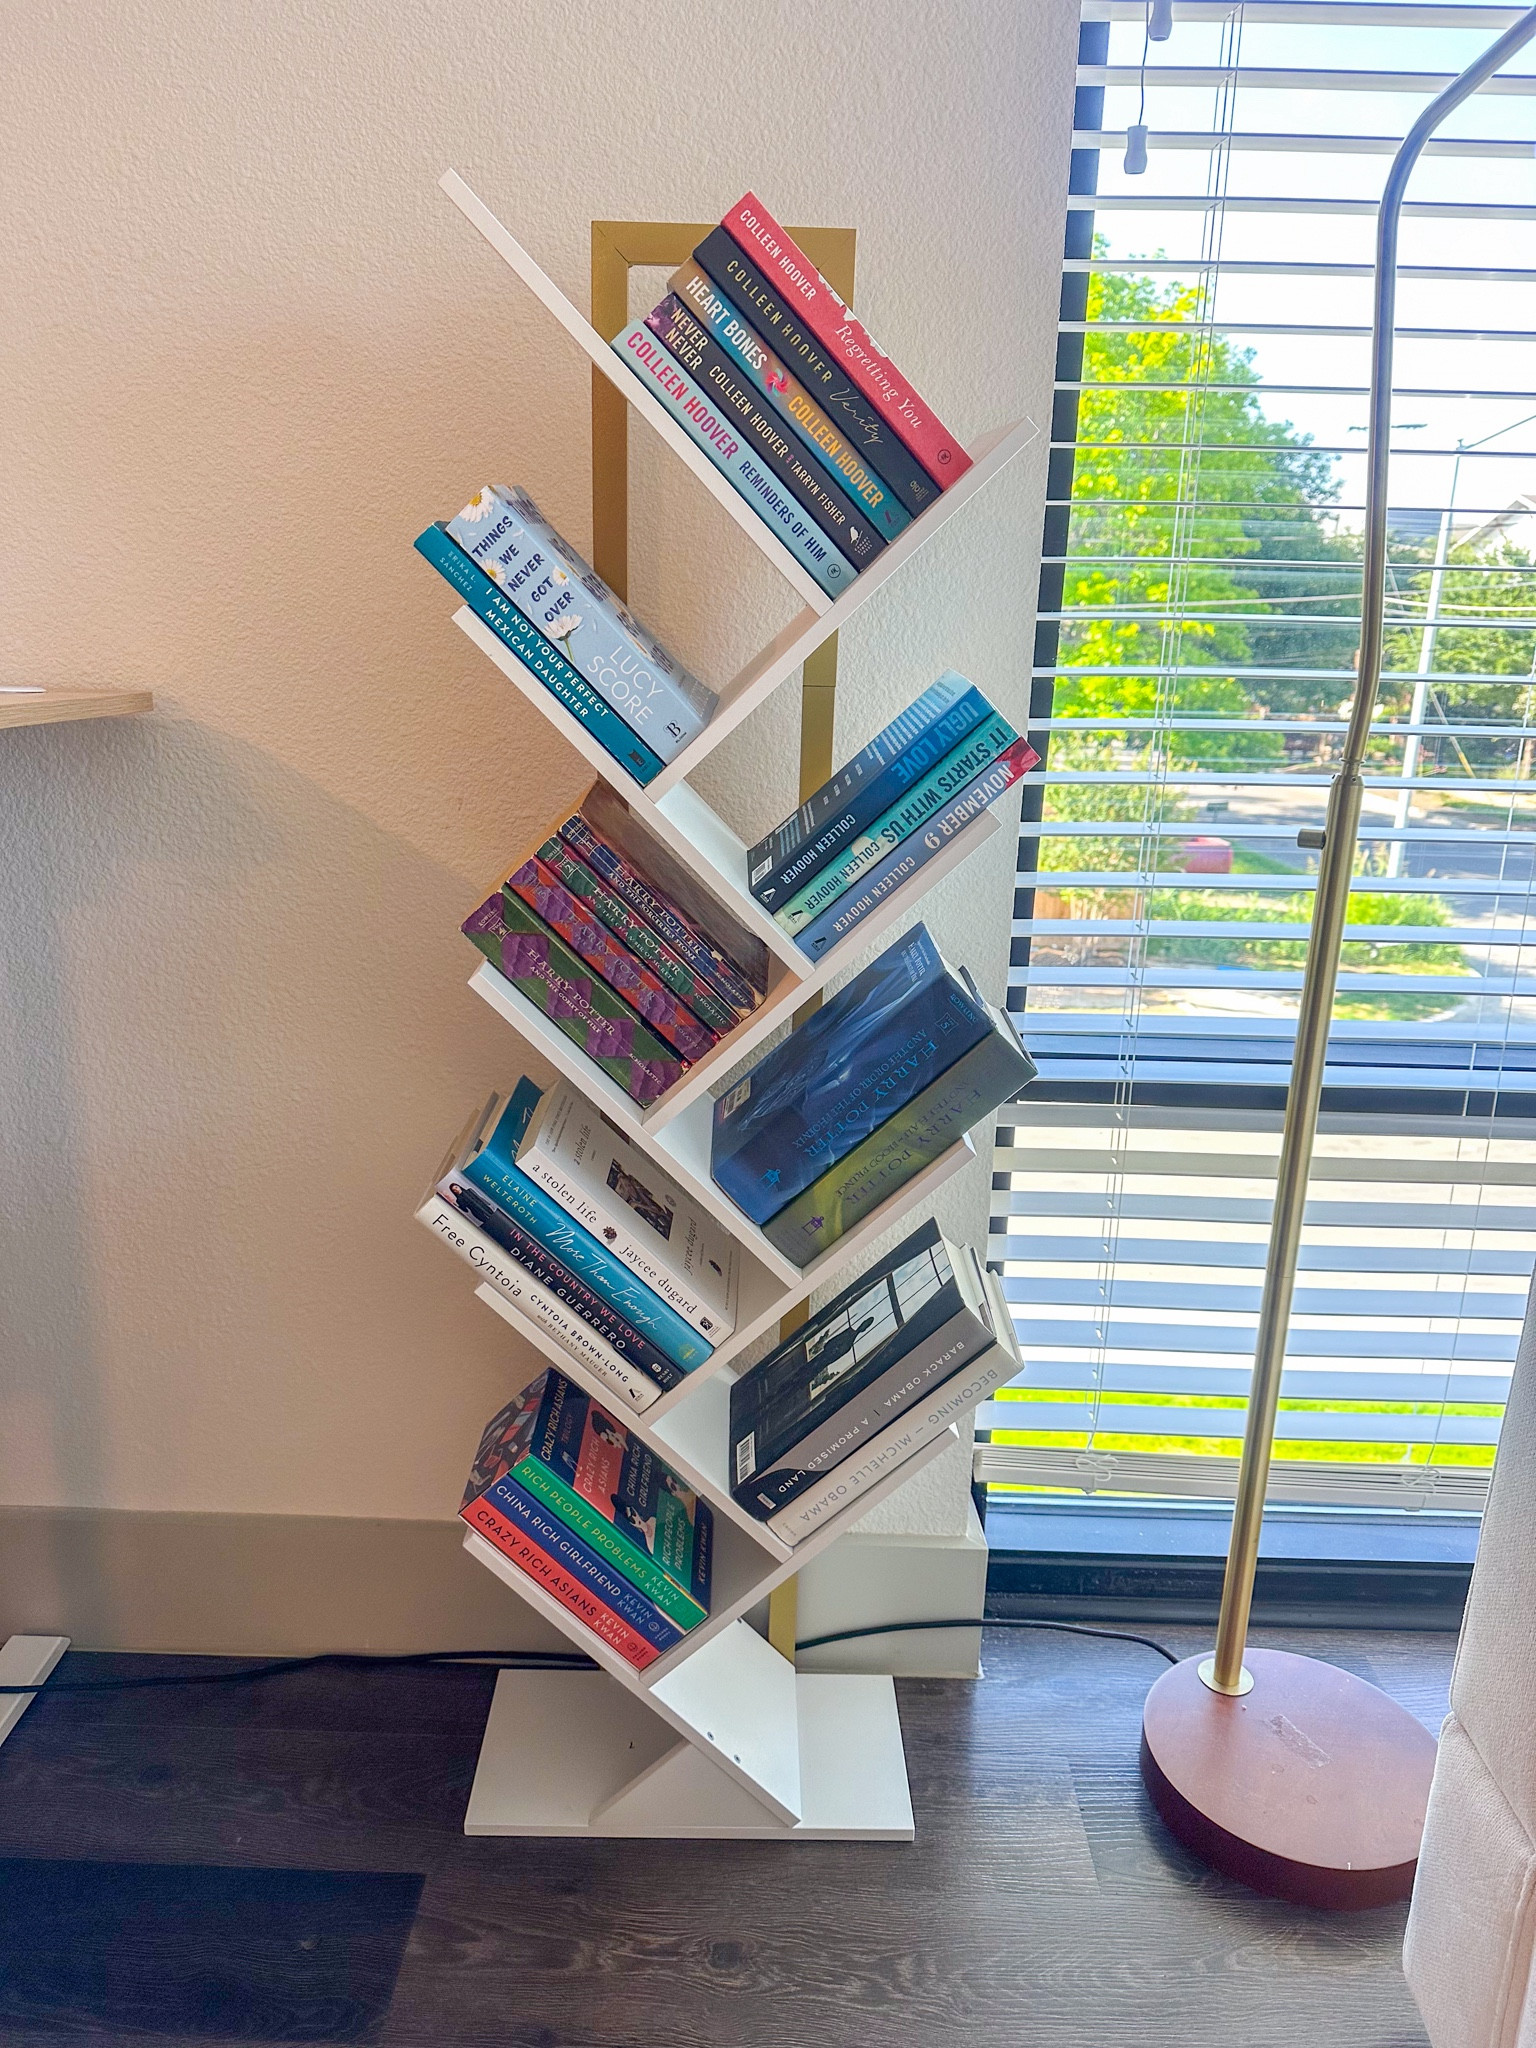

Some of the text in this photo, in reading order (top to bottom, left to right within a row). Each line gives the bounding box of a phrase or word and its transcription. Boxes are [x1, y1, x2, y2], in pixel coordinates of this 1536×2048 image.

[740, 209, 817, 300] COLLEEN HOOVER
[665, 327, 703, 371] NEVER
[671, 308, 709, 351] NEVER
[686, 276, 768, 370] HEART BONES
[727, 260, 833, 383] COLLEEN HOOVER
[627, 331, 739, 460] COLLEEN HOOVER
[835, 325, 899, 401] Regretting
[898, 398, 923, 429] You
[829, 388, 883, 444] Verity
[709, 365, 846, 526] COLLEEN HOOVER TARRYN FISHER
[788, 396, 884, 508] COLLEEN HOOVER
[472, 515, 514, 558] THINGS
[739, 460, 827, 562] REMINDERS OF HIM
[447, 550, 469, 575] ERIKA
[498, 544, 520, 566] WE
[507, 553, 545, 593] NEVER
[530, 576, 554, 603] GOT
[543, 591, 575, 623] OVER
[485, 587, 608, 717] I AM NOT YOUR PERFECT
[485, 609, 590, 718] MEXICAN DAUGHTER
[609, 645, 664, 698] LUCY
[586, 655, 654, 725] SCORE
[934, 700, 979, 747] UGLY
[880, 727, 1008, 844] IT STARTS WITH US
[891, 738, 938, 784] LOVE
[815, 813, 856, 853] COLLEEN
[924, 764, 1015, 849] NOVEMBER 9
[780, 849, 819, 884] HOOVER
[804, 841, 880, 910] COLLEEN HOOVER
[832, 856, 916, 932] COLLEEN HOOVER
[594, 886, 681, 976] HARRY POTTER
[608, 872, 697, 960] AND THE STONE
[614, 864, 701, 955] HARRY POTTER
[568, 914, 655, 1001] HARRY POTTER
[652, 959, 675, 981] SECRETS
[527, 949, 615, 1037] HARRY POTTER
[530, 966, 601, 1033] AND THE GOBLET OF FIRE
[694, 992, 726, 1025] SCHOLASTIC
[888, 1048, 908, 1066] THE
[907, 1029, 927, 1049] AND
[629, 1053, 662, 1084] SCHOLASTIC
[849, 1087, 862, 1100] OF
[860, 1063, 889, 1089] ORDER
[803, 1039, 939, 1157] HARRY POTTER
[792, 1113, 833, 1149] PHOENIX
[846, 1089, 981, 1205] HARRY POTTER
[483, 1173, 538, 1225] WELTEROTH
[502, 1175, 537, 1208] ELAINE
[532, 1163, 597, 1224] a stolen life
[835, 1165, 869, 1197] PRINCE
[432, 1214, 522, 1297] Free Cyntoia
[545, 1222, 662, 1330] More Than Enough
[619, 1244, 657, 1279] jaycee
[658, 1277, 699, 1315] dugard
[509, 1228, 646, 1350] IN THE COUNTRY WE LOVE
[510, 1247, 626, 1349] DIANE GUERRERO
[530, 1294, 629, 1383] CYNTOIA BROWN-LONG
[547, 1322, 580, 1353] BETHANY
[580, 1351, 609, 1377] MAUGER
[541, 1379, 568, 1461] CRAZY RICH ASIANS
[778, 1341, 965, 1494] BARACK OBAMA A PROMISED LAND
[800, 1369, 998, 1522] BECOMING MICHELLE OBAMA
[583, 1437, 600, 1493] CRAZY RICH
[598, 1457, 610, 1494] ASIANS
[627, 1442, 642, 1496] CHINA RICH
[639, 1453, 652, 1507] GIRLFRIEND
[496, 1485, 620, 1596] CHINA RICH GIRLFRIEND
[522, 1466, 647, 1579] RICH PEOPLE PROBLEMS
[675, 1516, 686, 1571] PROBLEMS
[477, 1510, 598, 1617] CRAZY RICH ASIANS
[662, 1539, 673, 1566] RICH
[617, 1599, 645, 1624] KWAN
[624, 1593, 652, 1619] KEVIN
[644, 1582, 672, 1606] KWAN
[651, 1576, 679, 1600] KEVIN
[593, 1619, 622, 1645] KWAN
[600, 1612, 630, 1639] KEVIN
